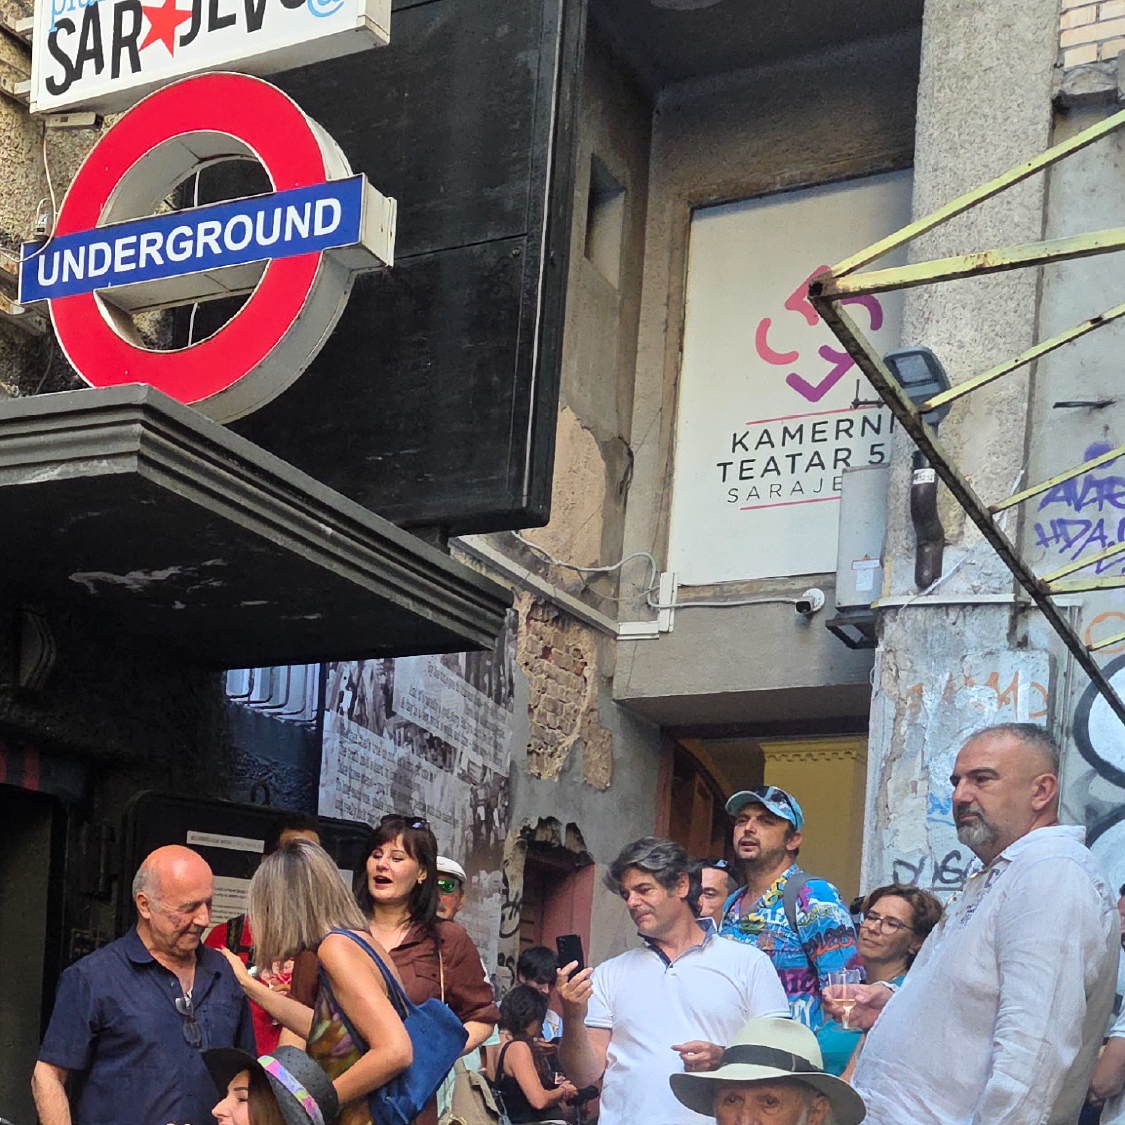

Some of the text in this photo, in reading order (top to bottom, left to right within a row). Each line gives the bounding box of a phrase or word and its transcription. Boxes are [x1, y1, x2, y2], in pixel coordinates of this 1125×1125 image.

[37, 197, 342, 287] UNDERGROUND
[732, 414, 895, 454] KAMERNI
[717, 447, 851, 483] TEATAR
